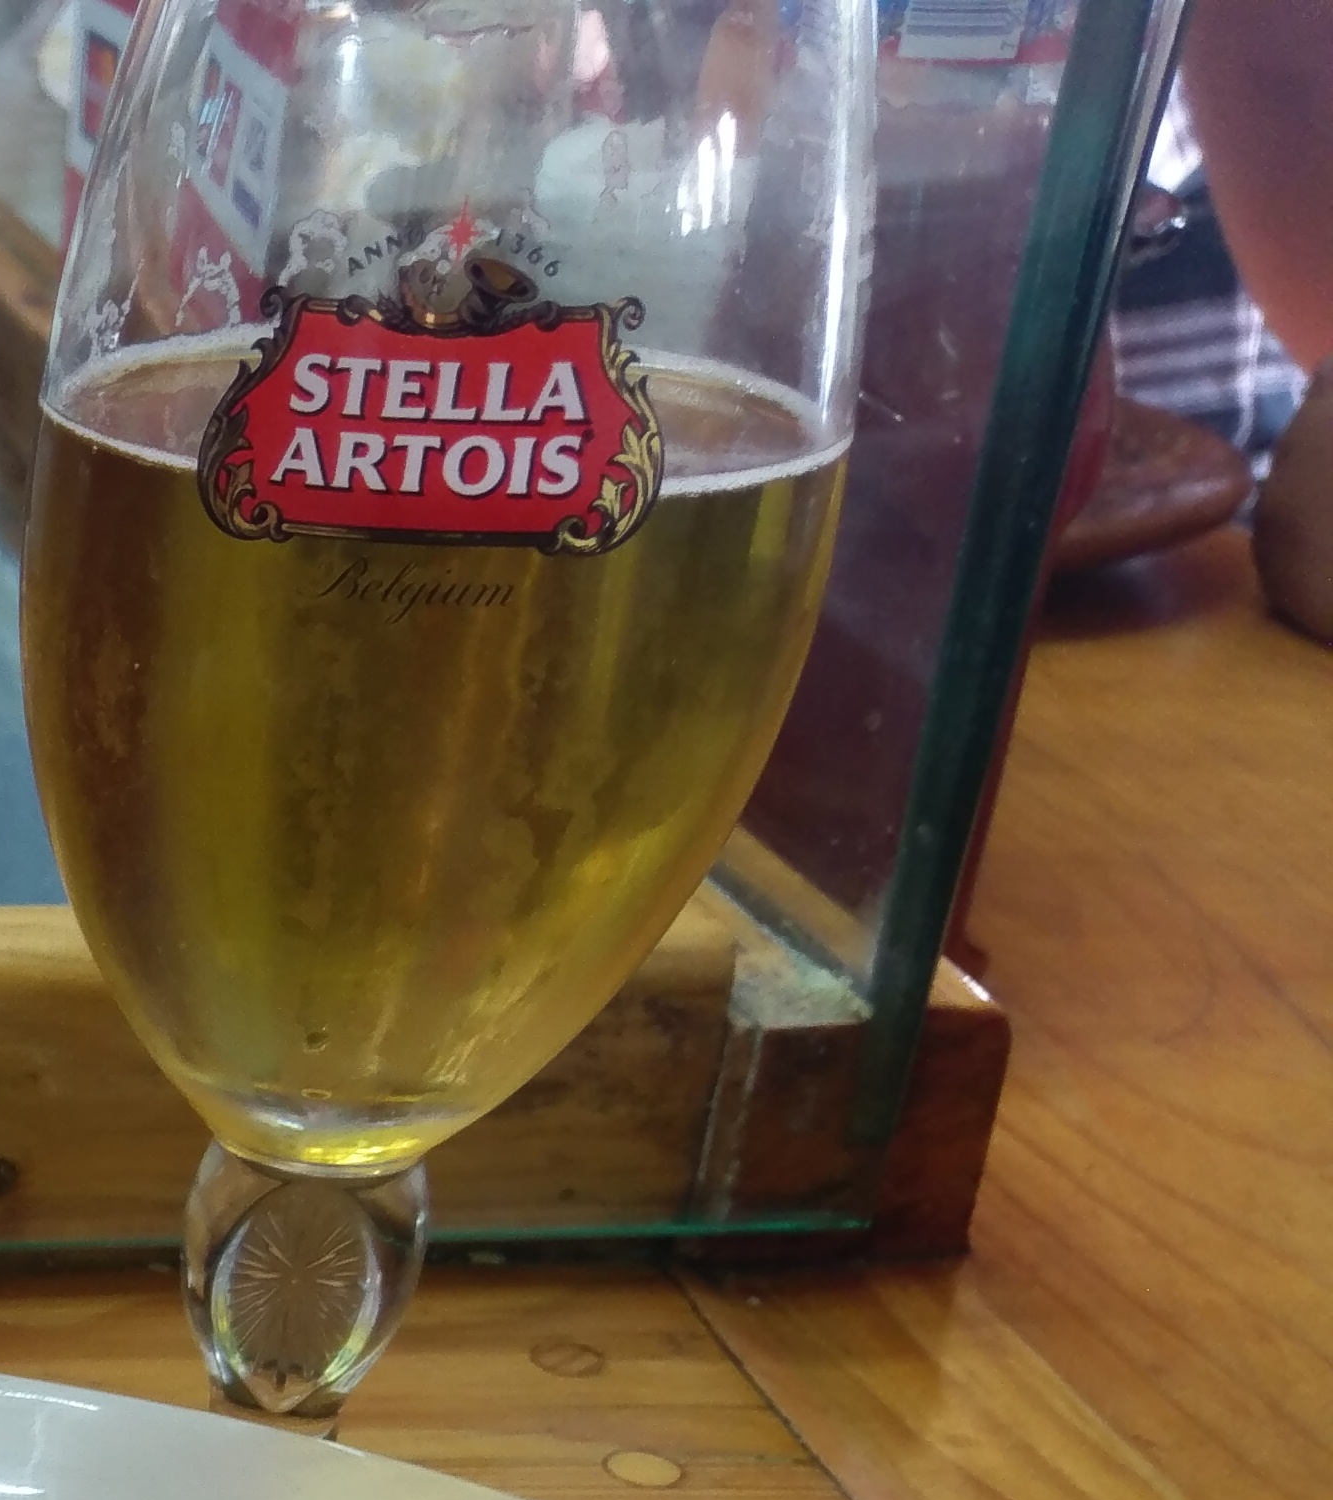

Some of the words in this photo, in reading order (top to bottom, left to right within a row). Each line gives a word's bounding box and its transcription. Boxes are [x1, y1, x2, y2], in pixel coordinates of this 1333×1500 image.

[347, 225, 424, 278] ANNO
[496, 228, 562, 278] 1366
[289, 354, 588, 423] STELLA
[270, 427, 585, 497] ARTOIS
[297, 556, 517, 624] Belgium
